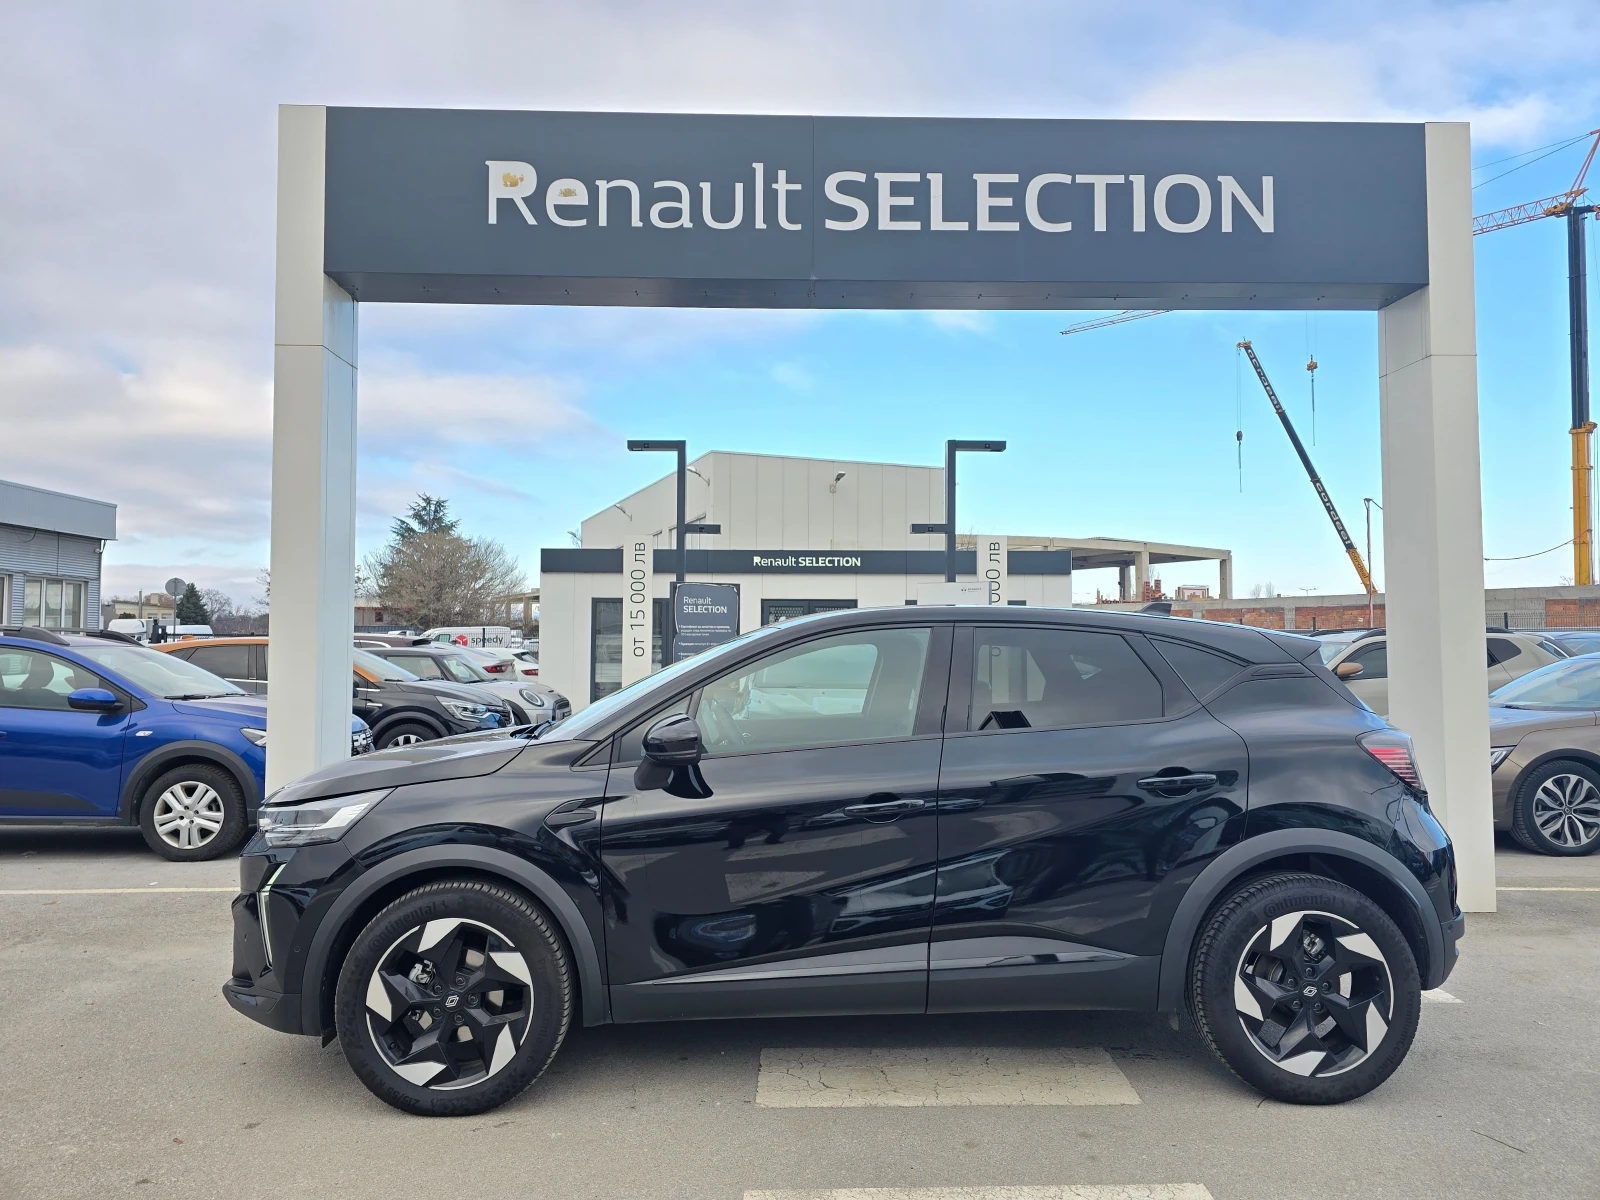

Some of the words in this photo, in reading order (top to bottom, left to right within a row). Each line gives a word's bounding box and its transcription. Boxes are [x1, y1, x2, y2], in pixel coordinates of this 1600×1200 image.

[485, 160, 802, 231] Renault
[824, 170, 1275, 234] SELECTION
[634, 542, 646, 564] лв
[753, 556, 796, 567] Renault
[799, 557, 861, 567] SELECTION
[989, 542, 1000, 564] лв
[630, 569, 646, 604] 000
[683, 596, 712, 605] Renault
[683, 605, 727, 614] SELECTION
[630, 609, 645, 631] 15
[471, 635, 504, 645] speedy
[633, 637, 645, 657] от
[1262, 893, 1336, 918] Continental
[367, 902, 438, 953] Continental
